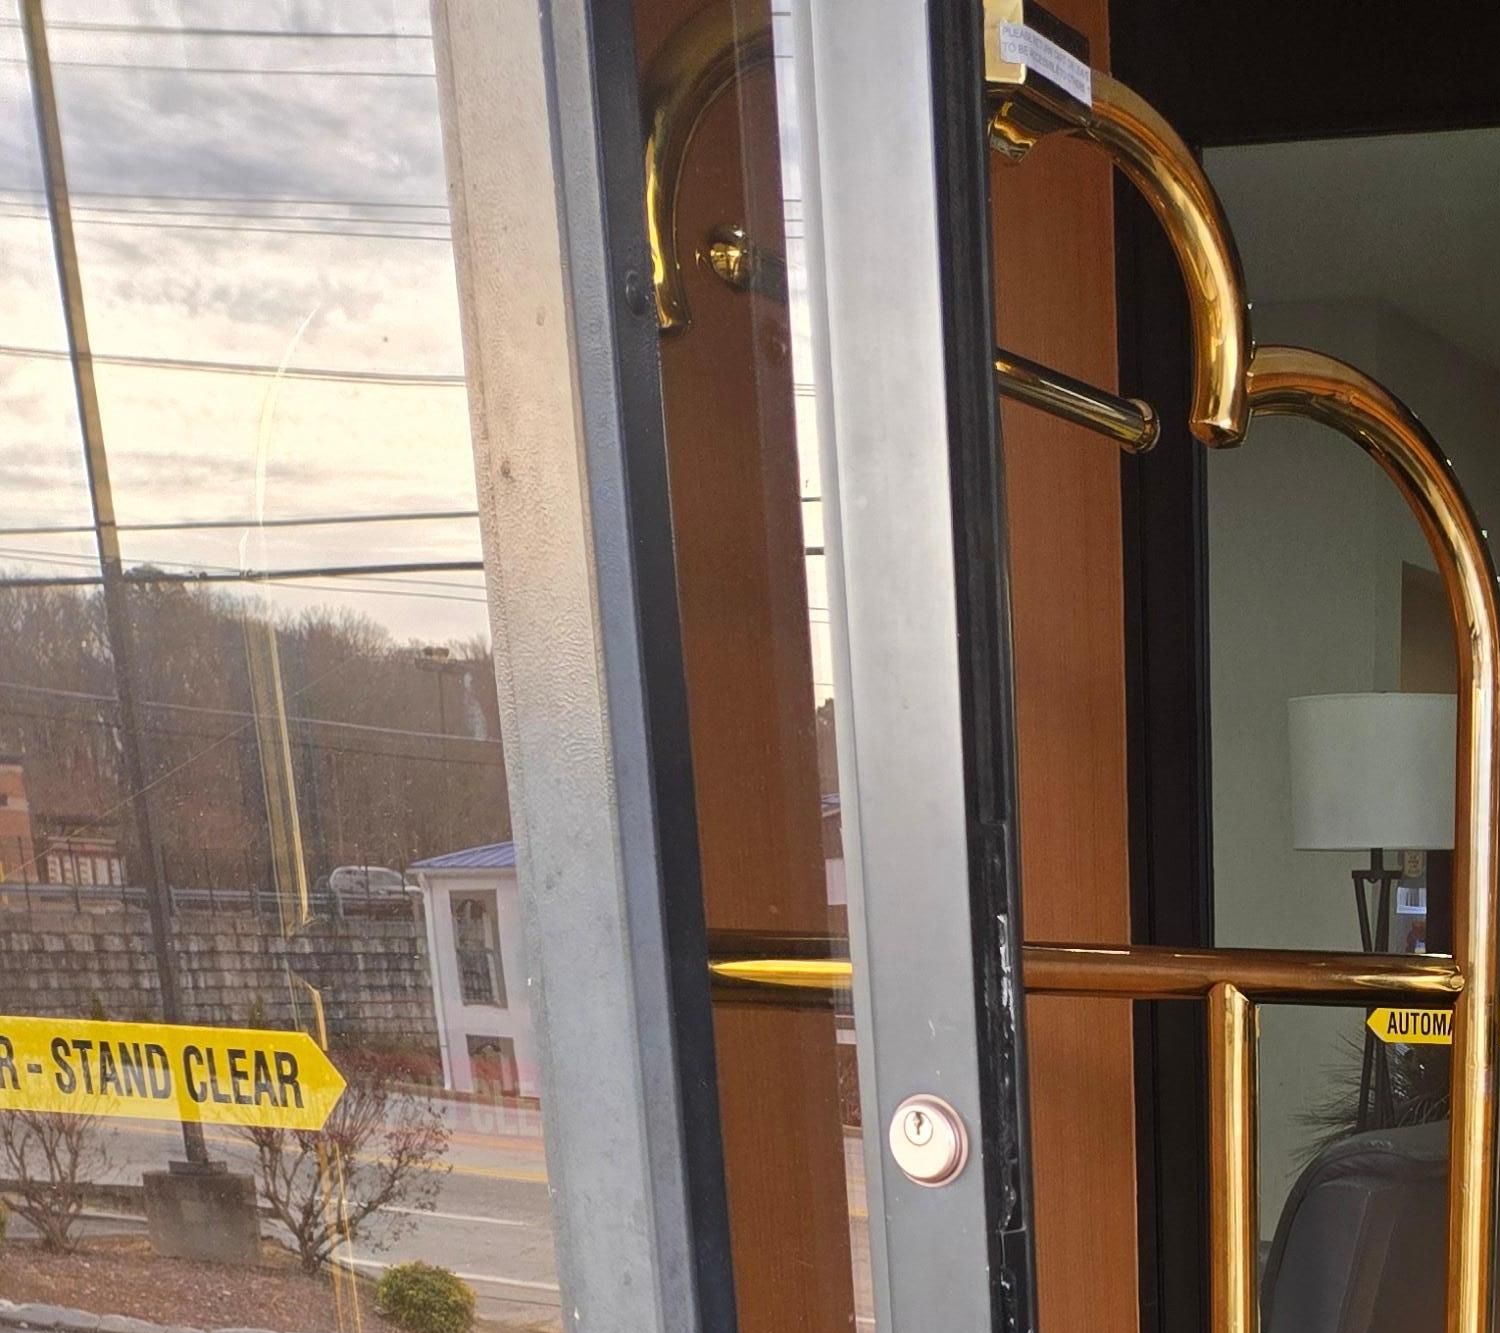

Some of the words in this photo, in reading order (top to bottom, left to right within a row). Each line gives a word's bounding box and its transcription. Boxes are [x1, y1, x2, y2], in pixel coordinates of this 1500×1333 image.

[1387, 1012, 1453, 1036] AUTOM
[50, 1037, 172, 1100] STAND
[182, 1045, 304, 1109] CLEAR
